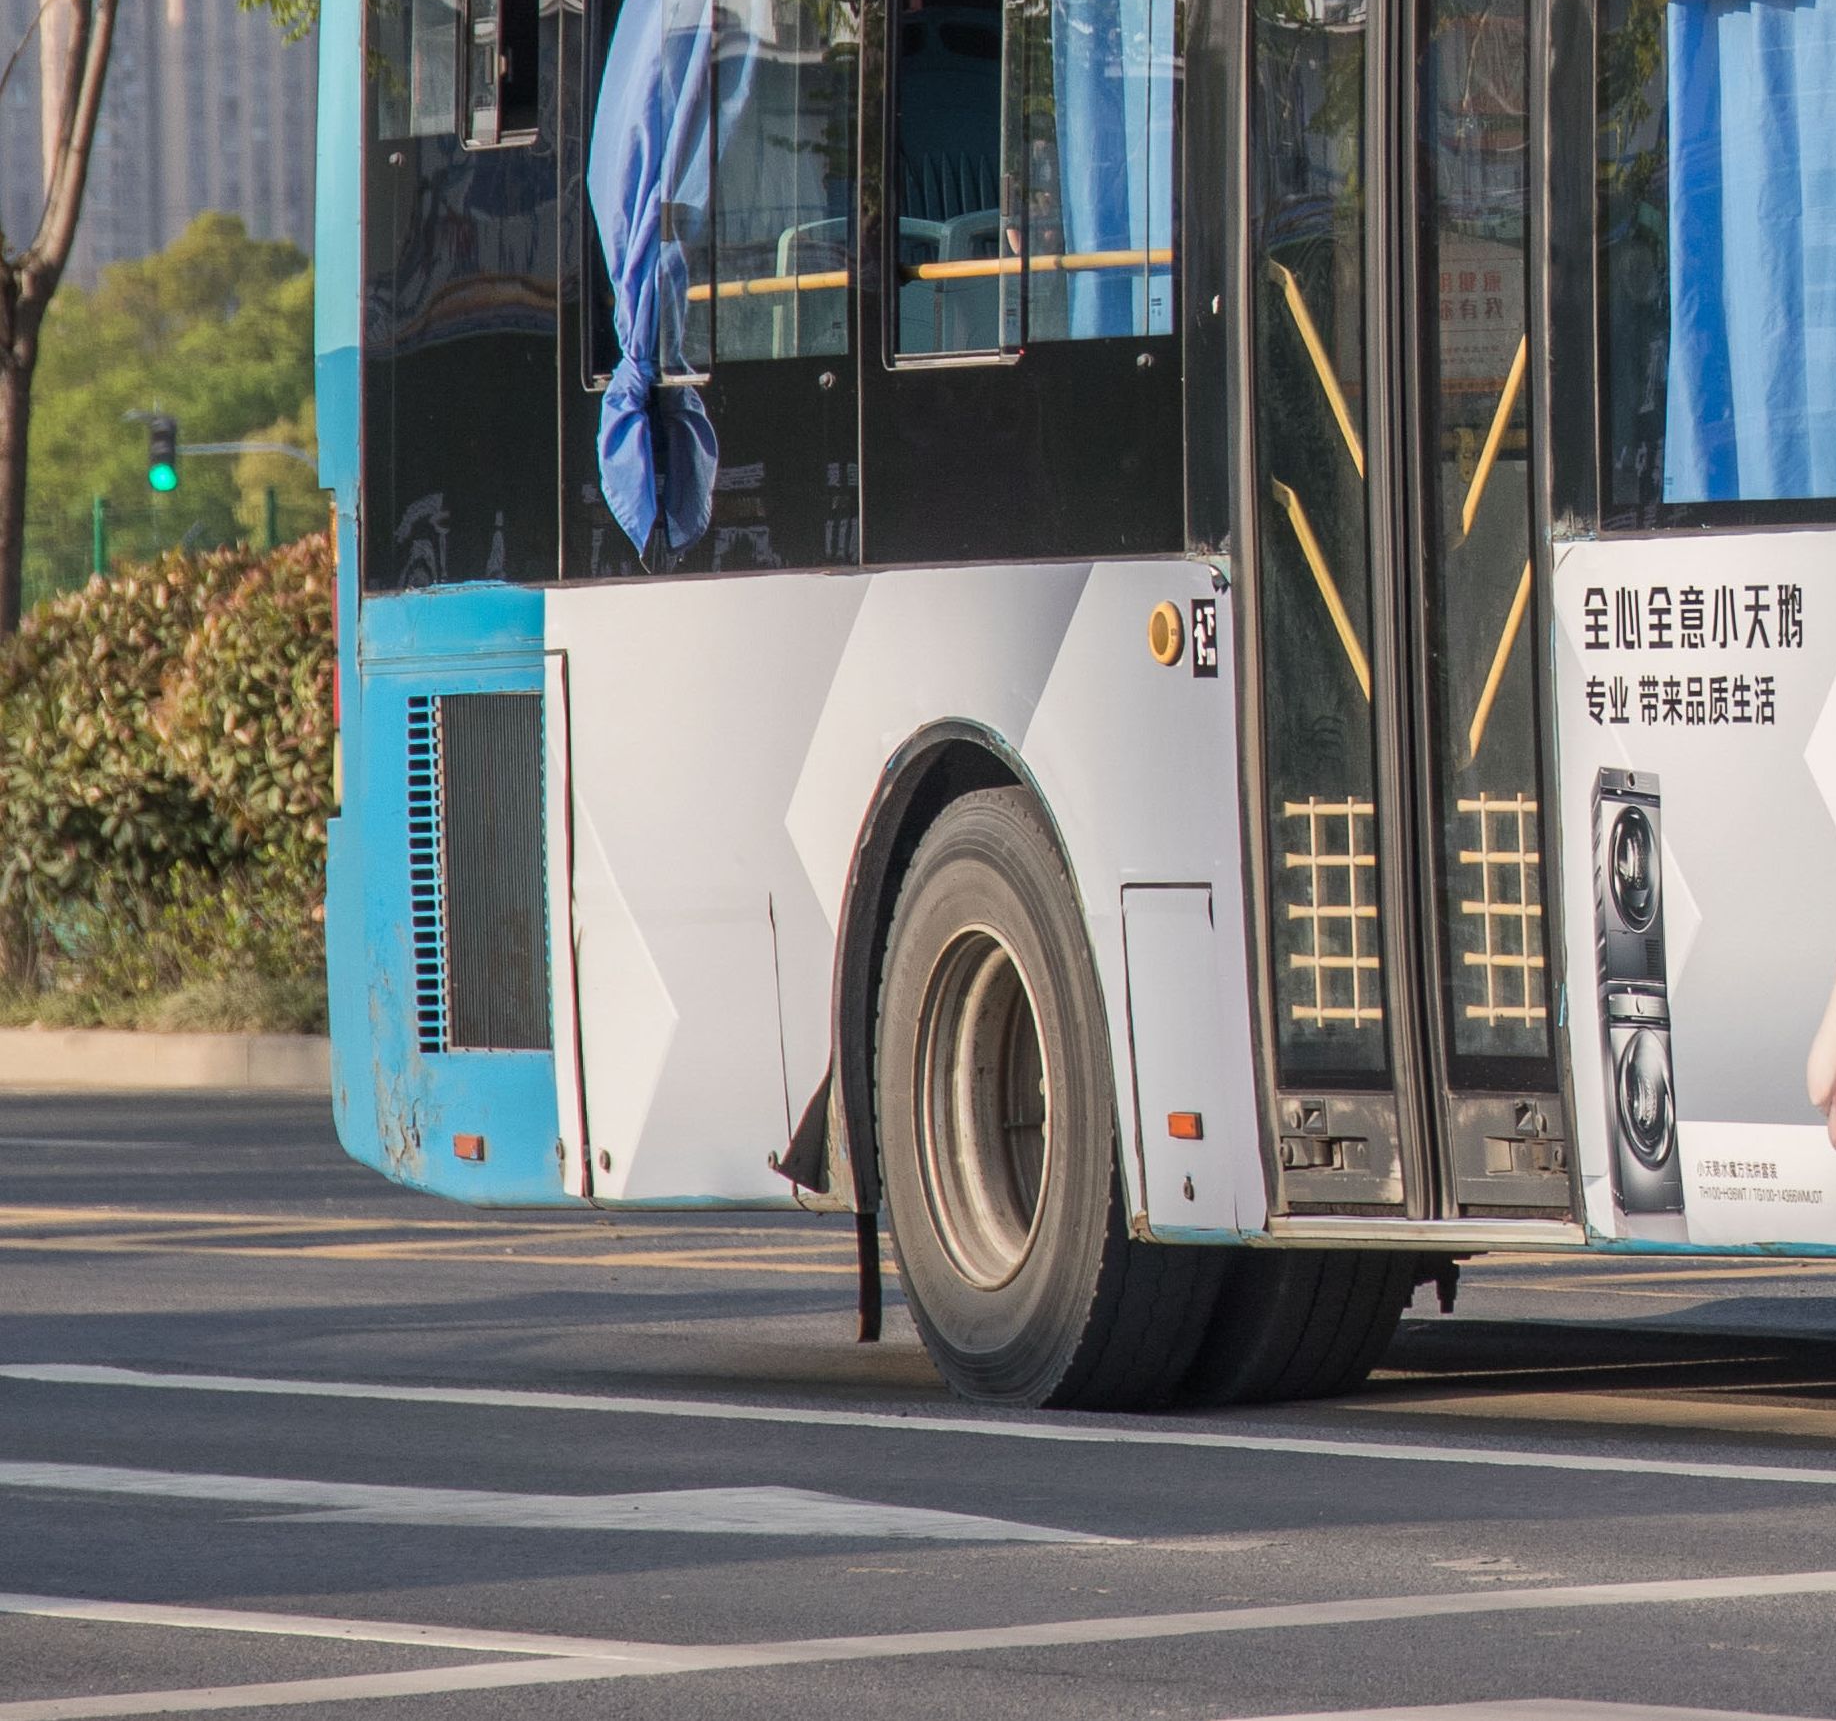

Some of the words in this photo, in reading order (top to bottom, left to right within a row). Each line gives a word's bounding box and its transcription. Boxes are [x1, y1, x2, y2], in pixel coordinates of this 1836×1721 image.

[1583, 583, 1804, 651] 全心全意小天鹅
[1585, 677, 1631, 727] 专业
[1637, 674, 1776, 727] 带来品质生活
